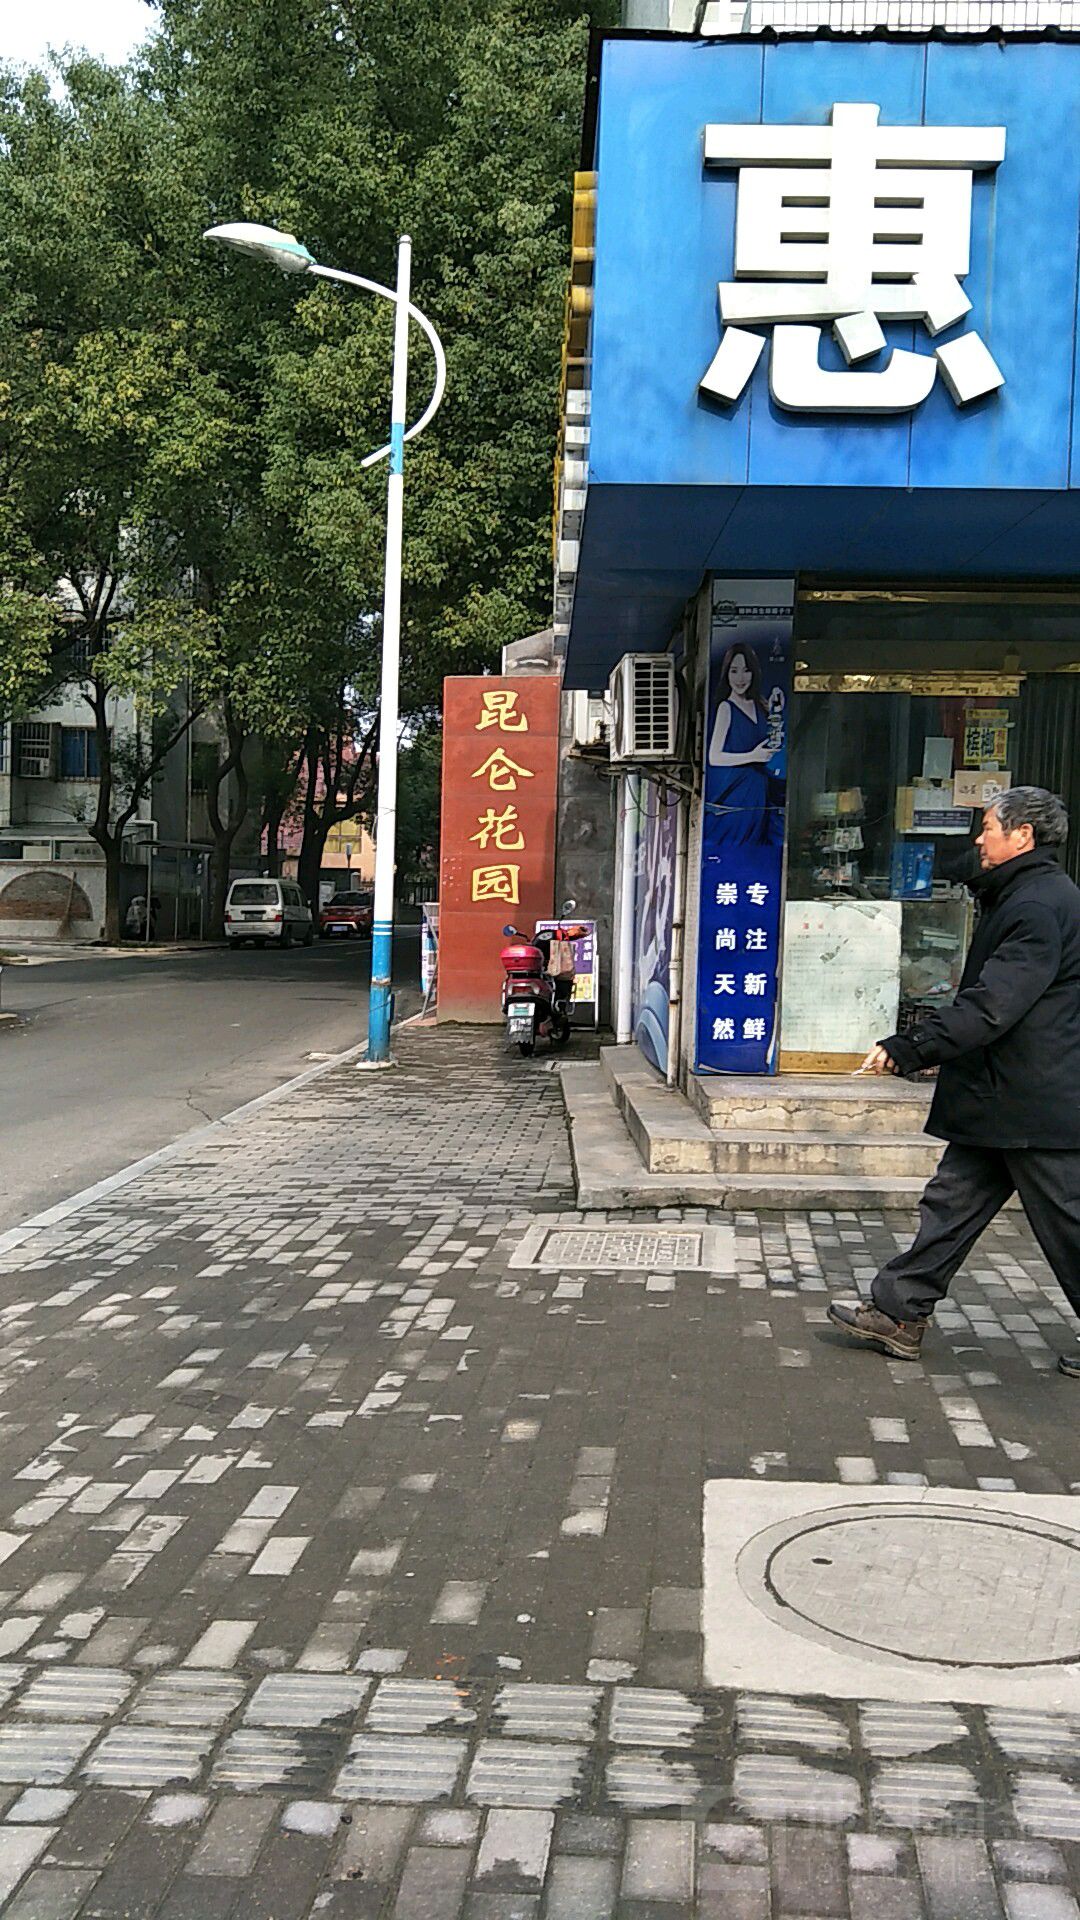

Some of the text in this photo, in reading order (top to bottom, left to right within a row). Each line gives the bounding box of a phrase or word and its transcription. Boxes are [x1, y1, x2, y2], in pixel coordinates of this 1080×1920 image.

[700, 102, 1006, 412] 惠
[469, 689, 535, 905] 昆仑花园
[712, 882, 738, 1041] 崇尚天然
[742, 882, 769, 1041] 专注新鲜
